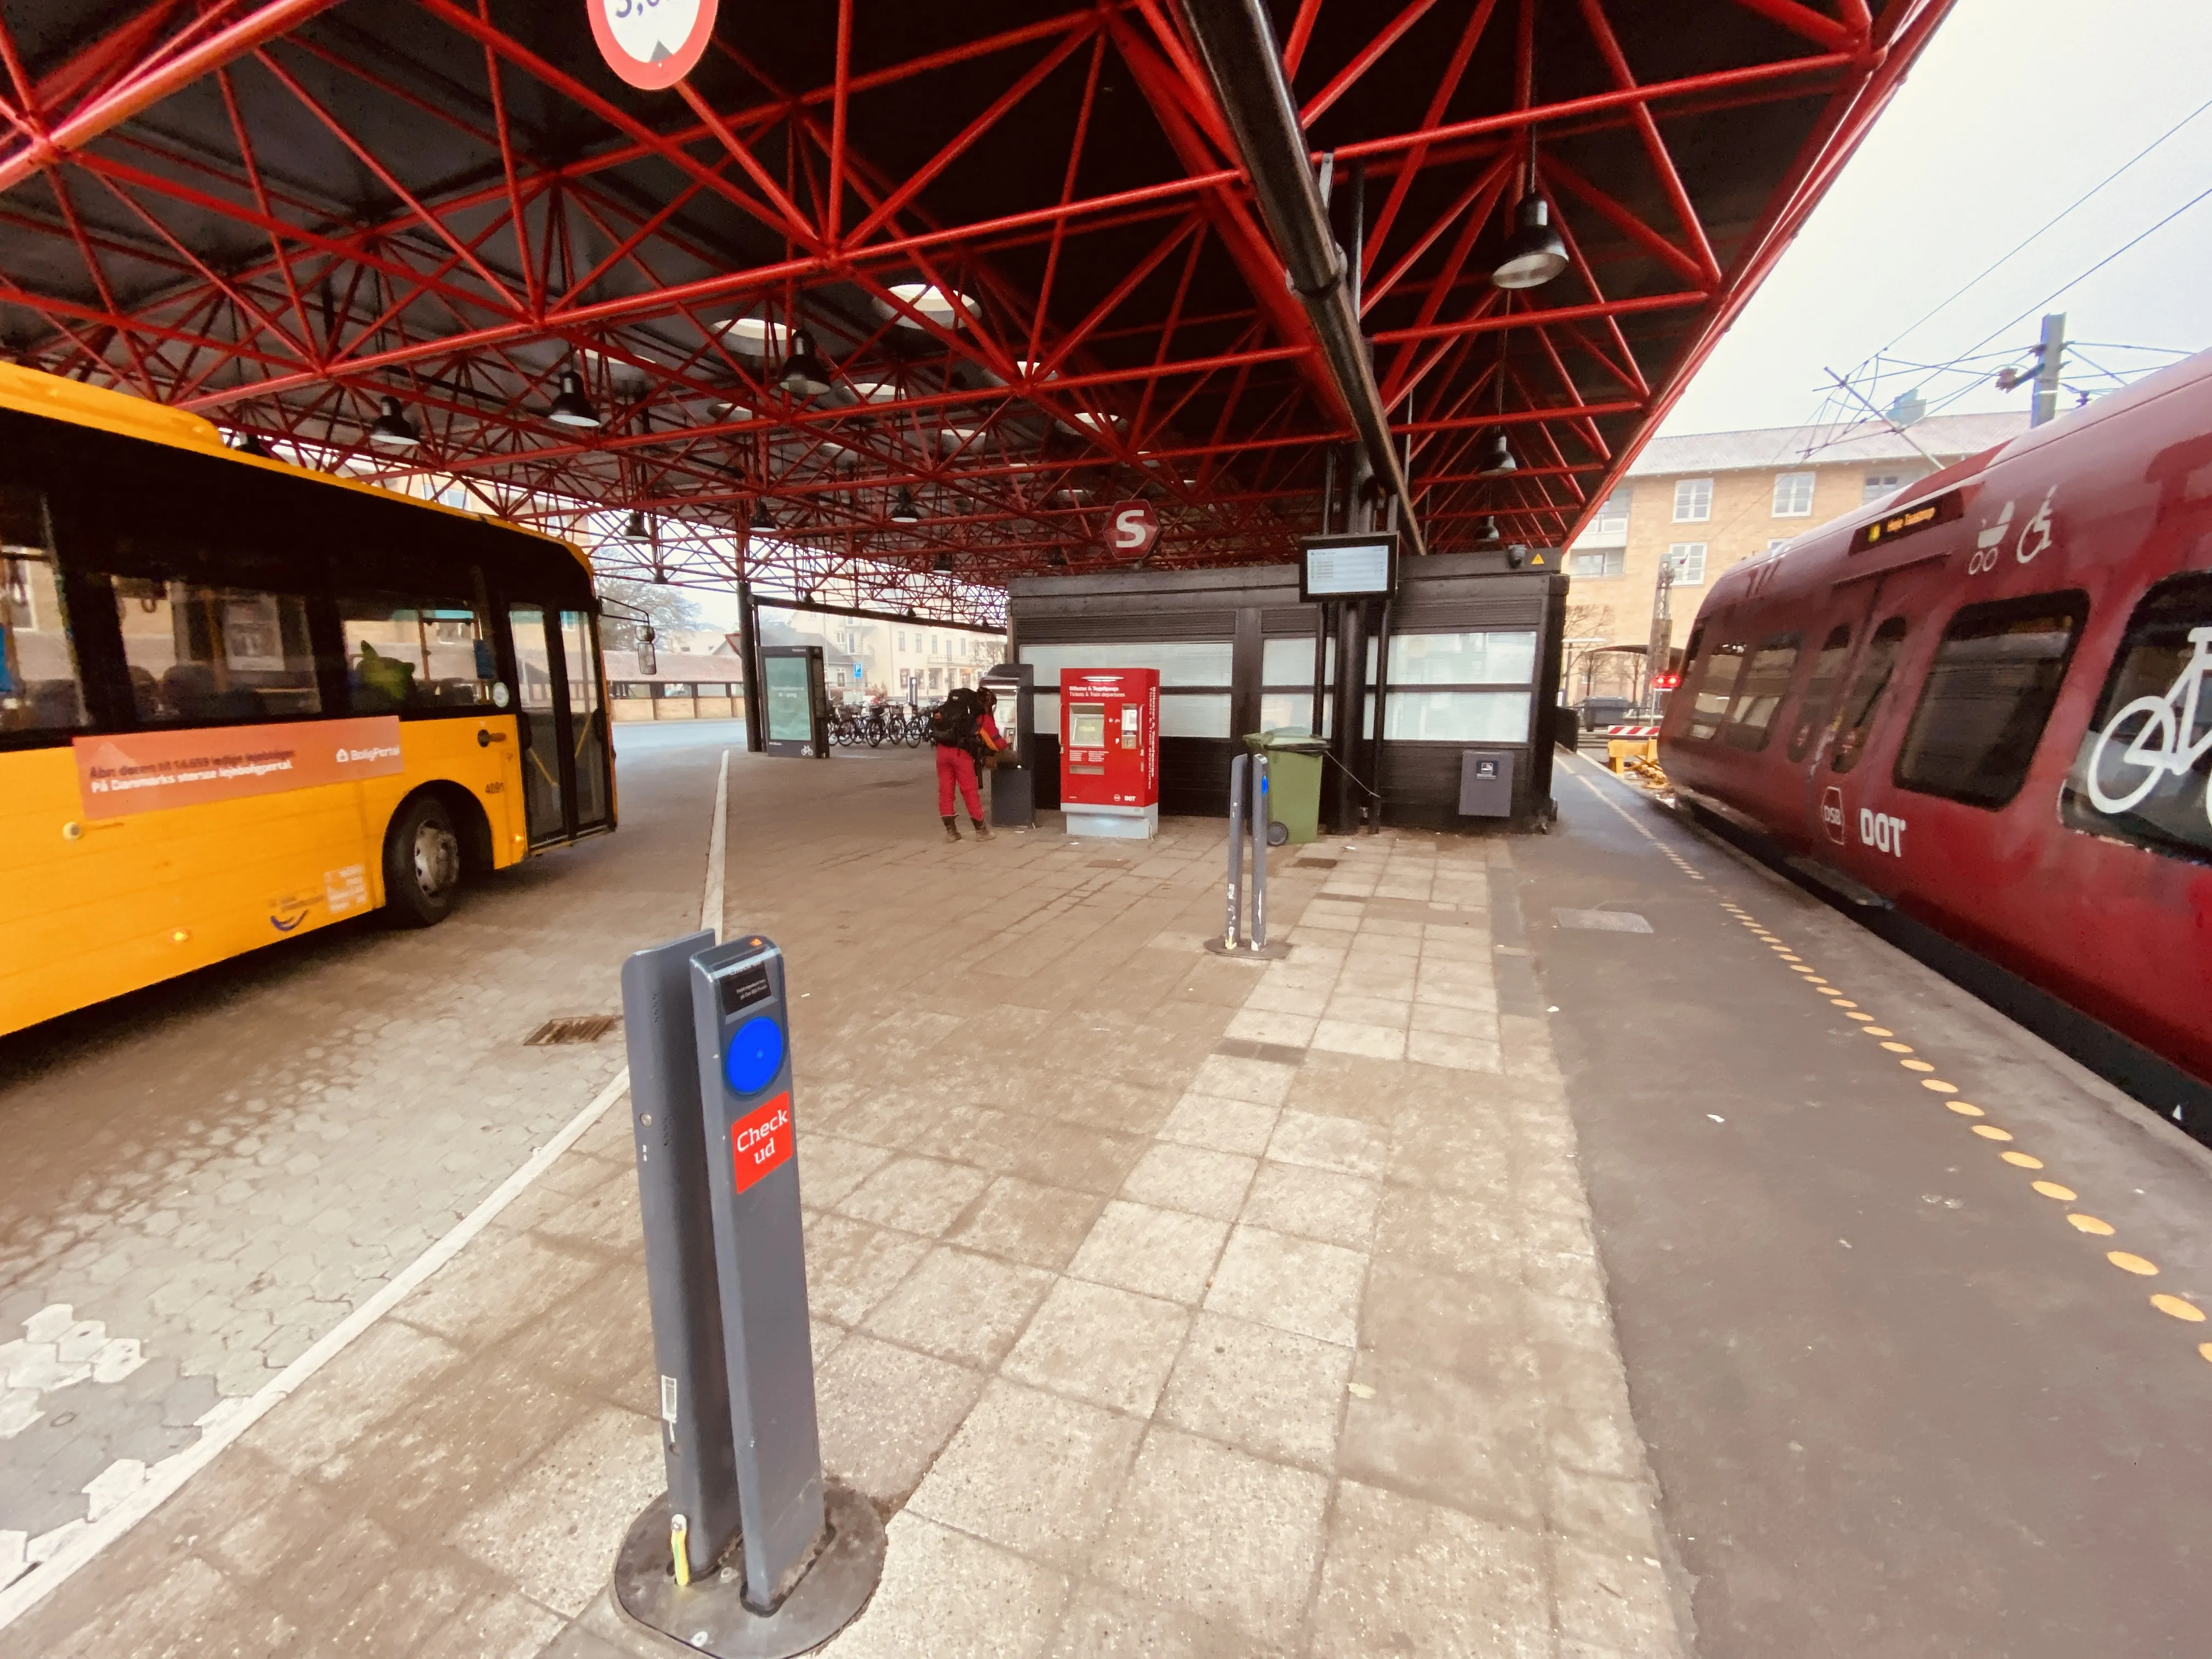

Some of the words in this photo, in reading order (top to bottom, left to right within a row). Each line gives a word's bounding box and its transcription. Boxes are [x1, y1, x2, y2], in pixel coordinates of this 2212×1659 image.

[1116, 510, 1146, 548] S
[351, 746, 400, 761] BoligPortal
[111, 774, 176, 791] Danmarks
[1860, 808, 1906, 857] DOT
[737, 1109, 789, 1153] Check
[753, 1137, 776, 1164] ud
